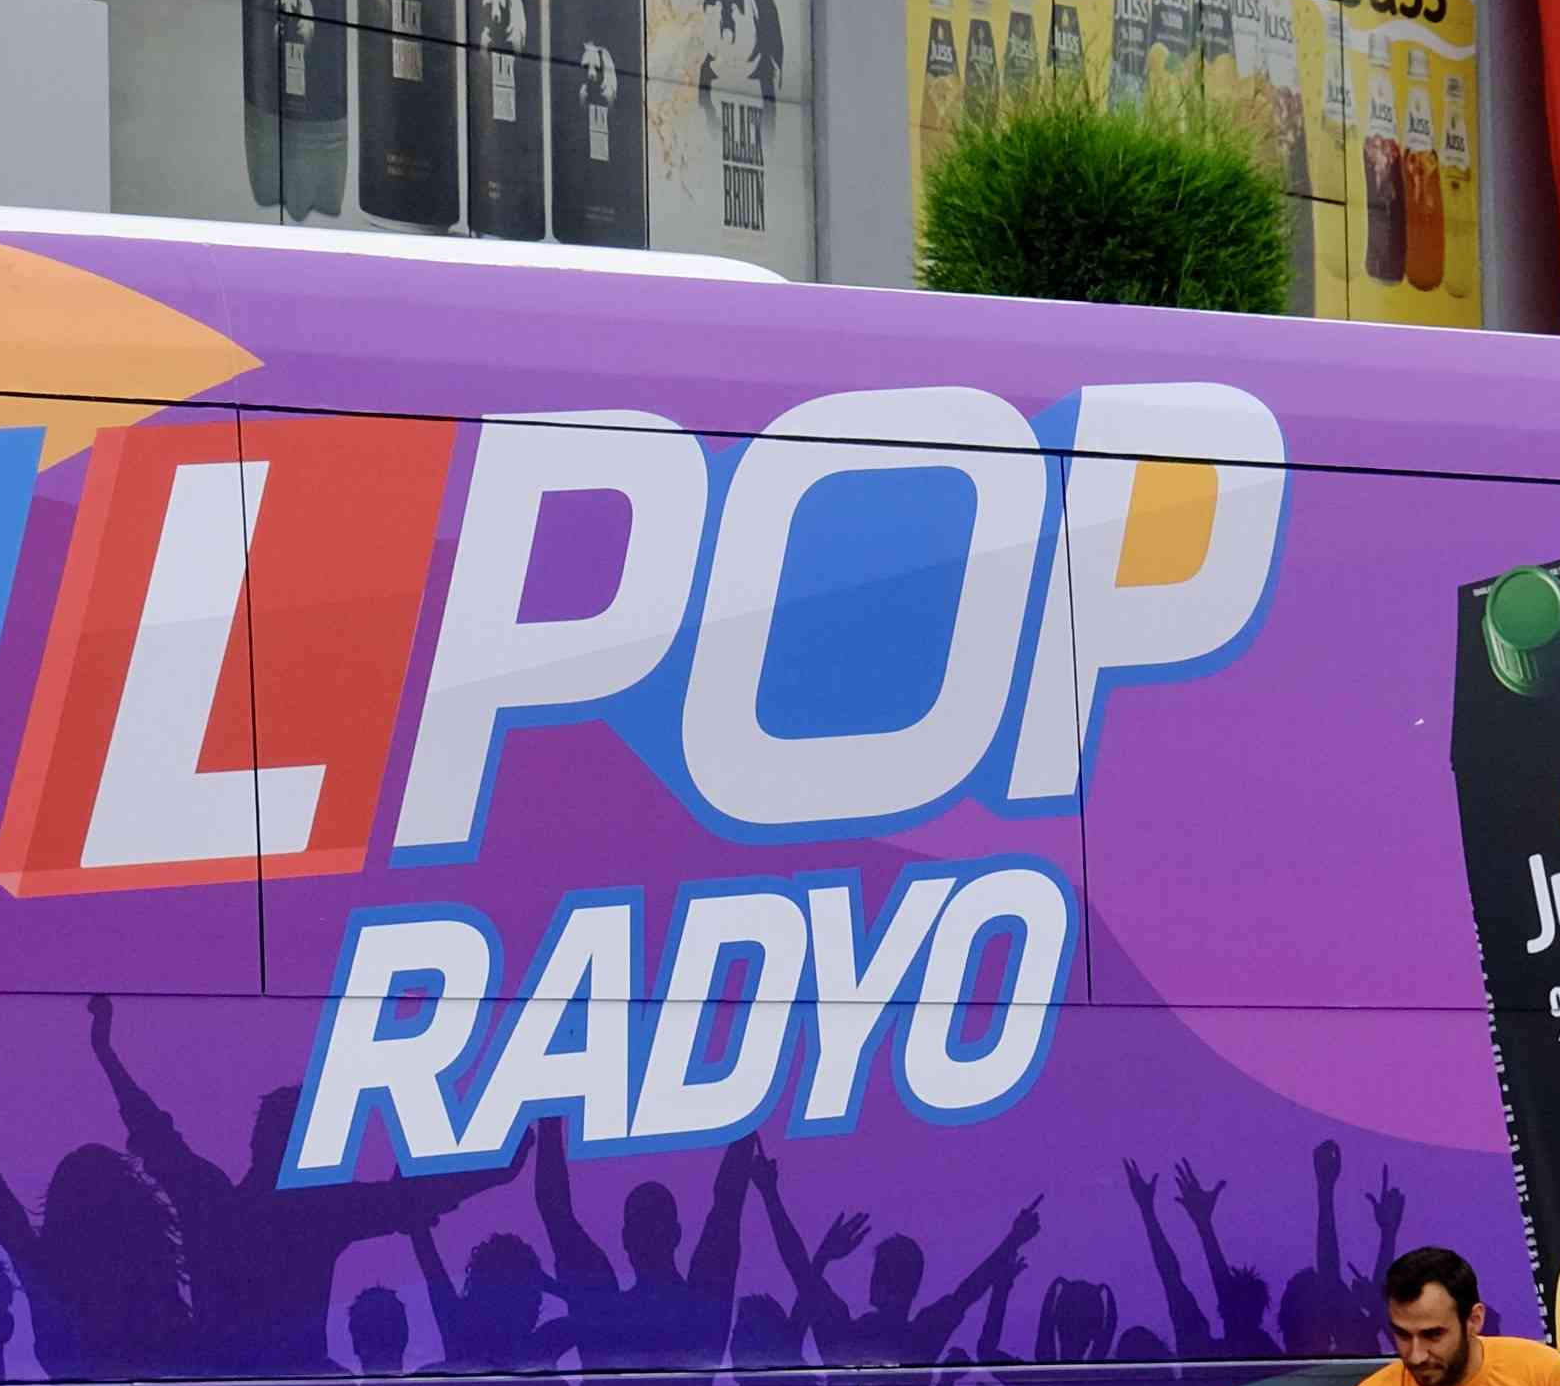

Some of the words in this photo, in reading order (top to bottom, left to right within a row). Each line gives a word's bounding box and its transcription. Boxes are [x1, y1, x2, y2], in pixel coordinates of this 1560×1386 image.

[721, 101, 764, 166] BLACK
[723, 164, 766, 231] BRUIN
[393, 381, 1285, 846] POP
[294, 867, 1069, 1171] RADYO
